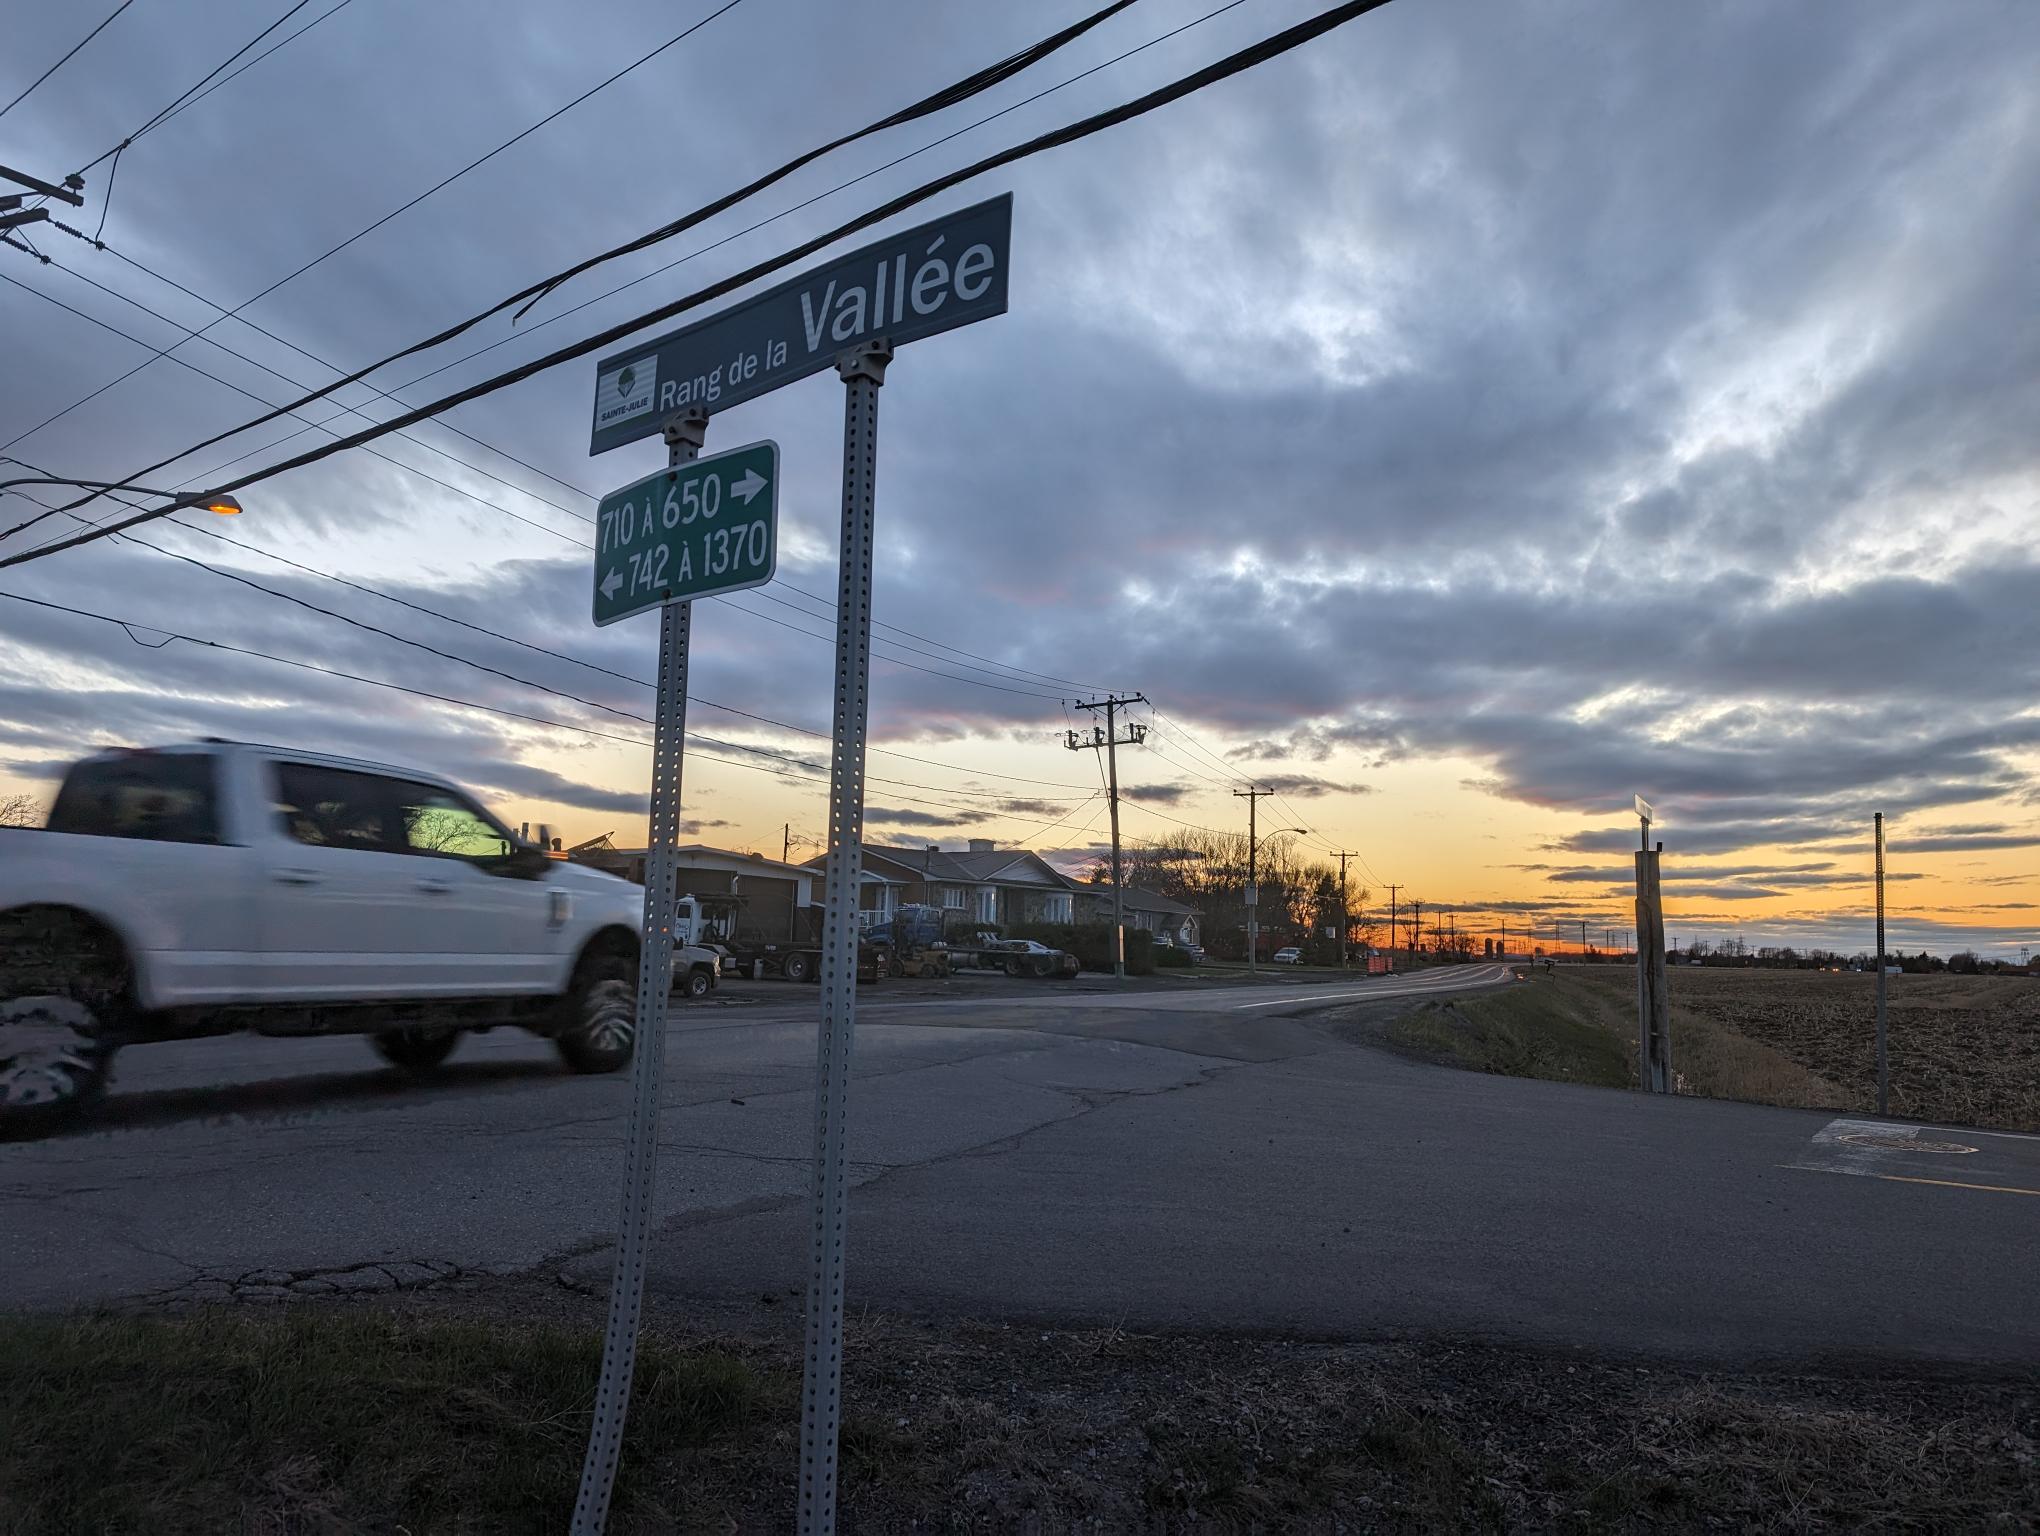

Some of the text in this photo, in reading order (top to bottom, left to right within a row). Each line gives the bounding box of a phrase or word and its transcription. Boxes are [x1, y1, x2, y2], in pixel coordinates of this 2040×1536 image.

[659, 235, 995, 412] Rang de la Vallée
[601, 397, 648, 421] SAINTE-JULIE
[602, 502, 634, 554] 710
[662, 473, 721, 529] 650
[629, 543, 669, 597] 742
[704, 519, 767, 577] 1370
